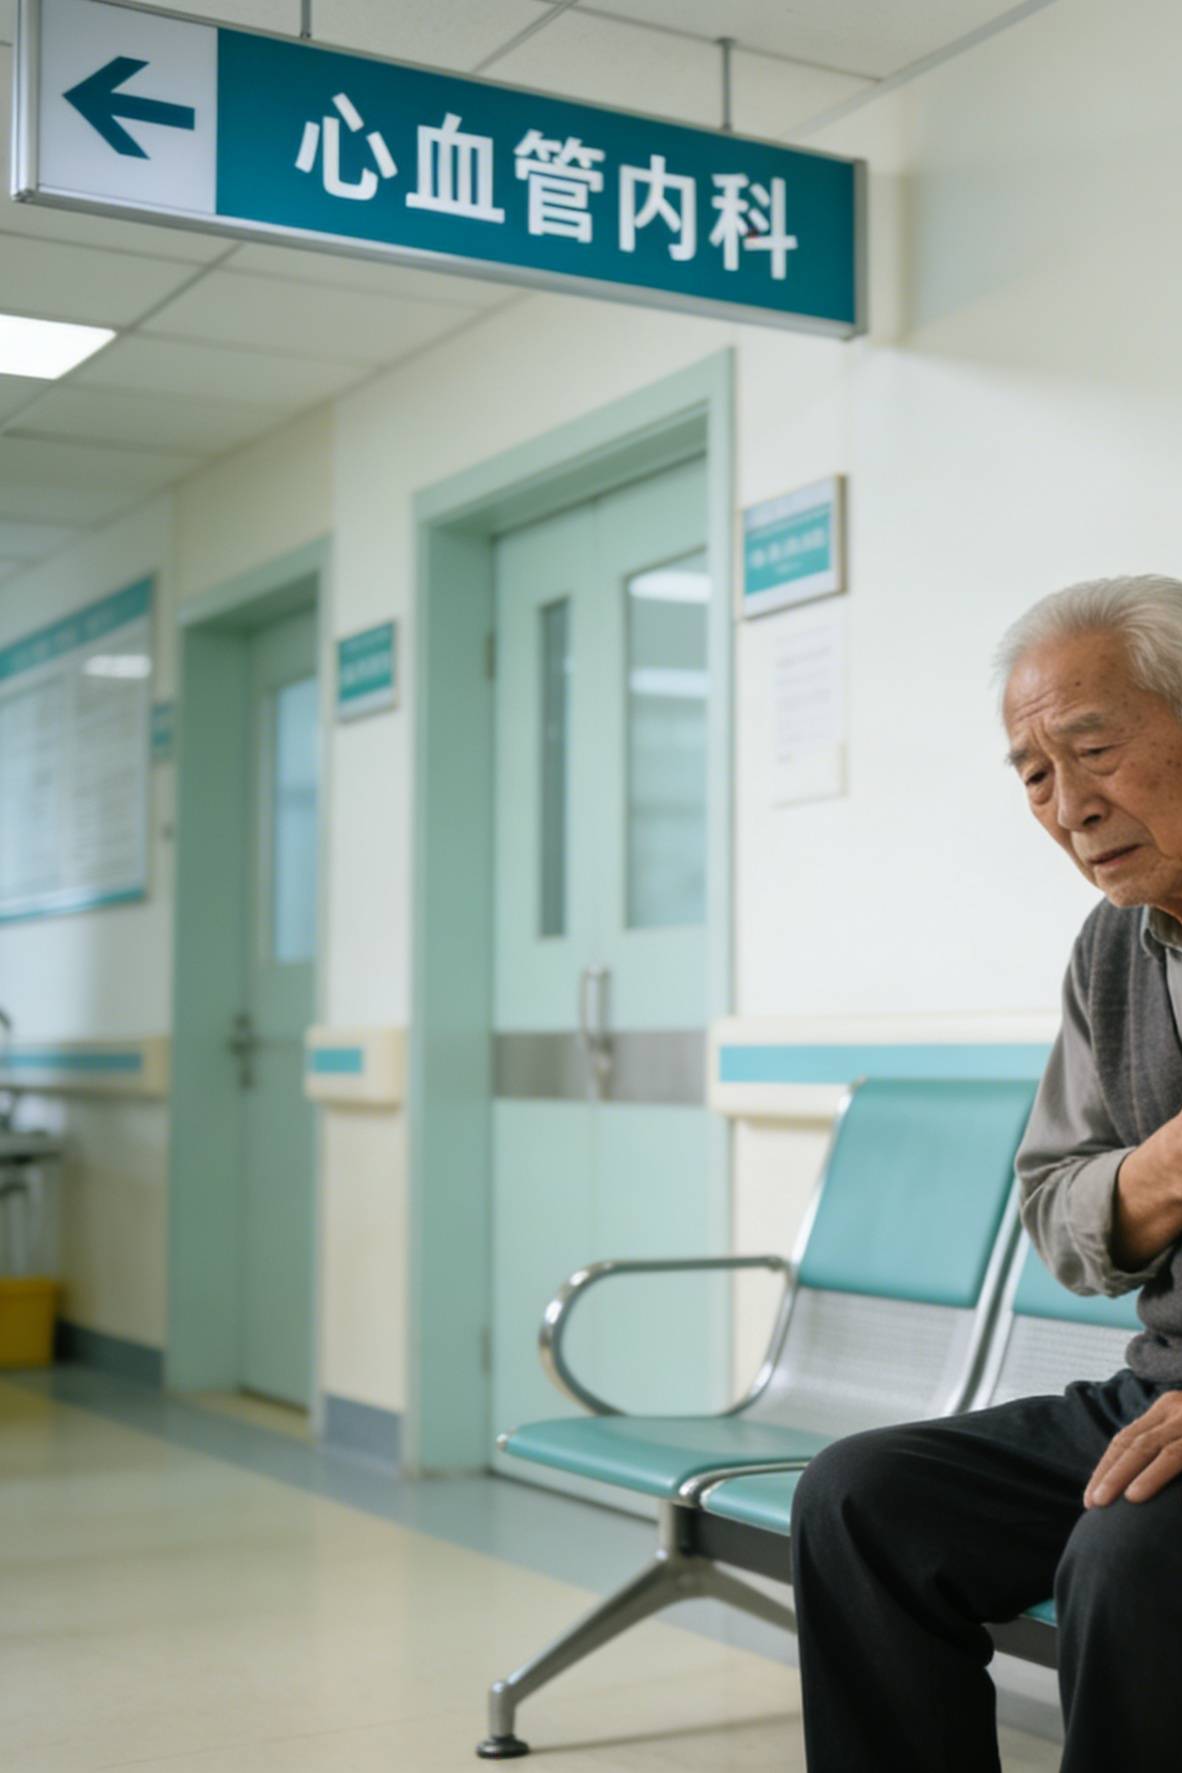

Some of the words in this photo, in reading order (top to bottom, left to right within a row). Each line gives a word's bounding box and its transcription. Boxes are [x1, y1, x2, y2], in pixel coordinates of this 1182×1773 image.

[295, 93, 798, 280] 心血管内科
